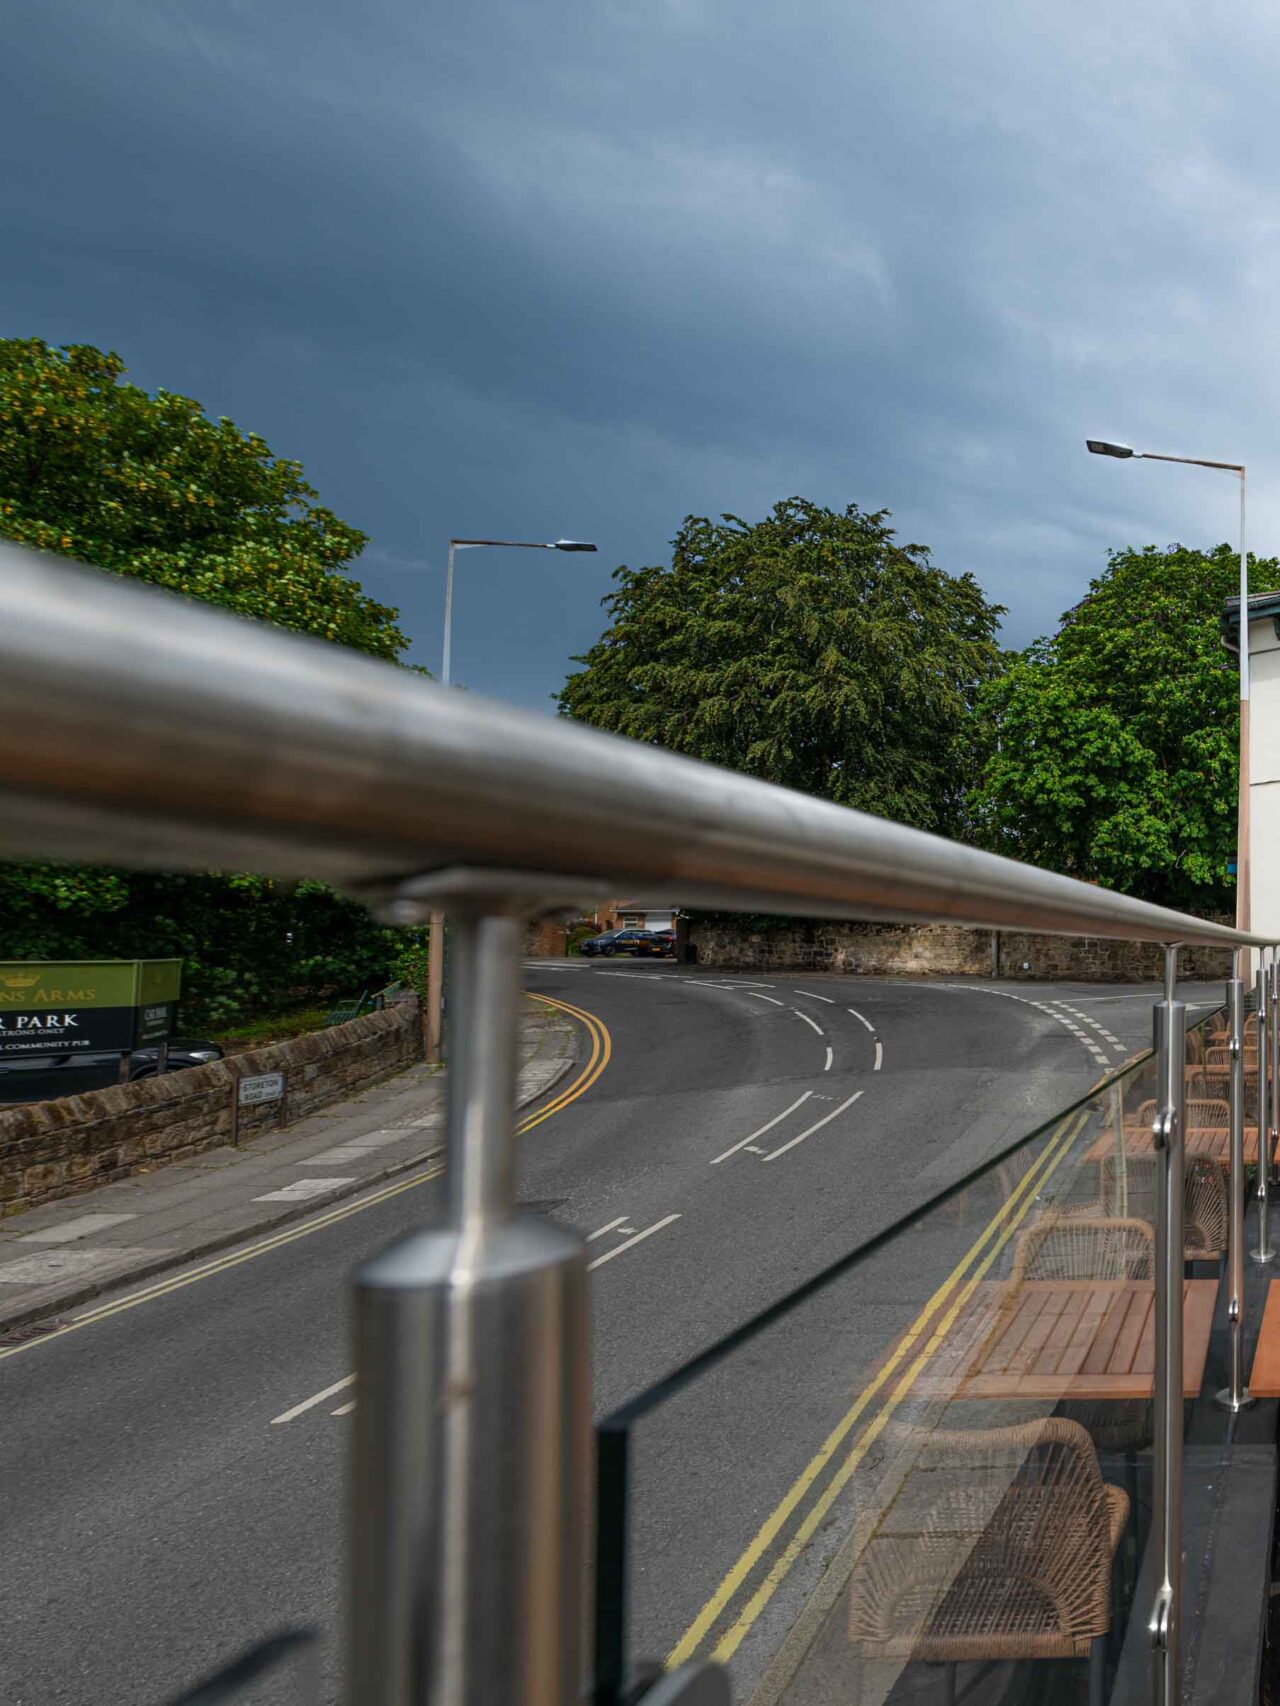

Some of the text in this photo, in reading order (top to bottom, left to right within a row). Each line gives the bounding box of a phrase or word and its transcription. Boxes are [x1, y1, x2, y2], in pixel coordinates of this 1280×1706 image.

[33, 988, 96, 1002] ARMS
[16, 1014, 79, 1029] PARK
[37, 1027, 66, 1035] ONLY
[5, 1040, 70, 1050] COMMUNITY
[71, 1039, 91, 1047] PUB
[242, 1079, 279, 1092] STORETON
[244, 1090, 263, 1101] ROAD
